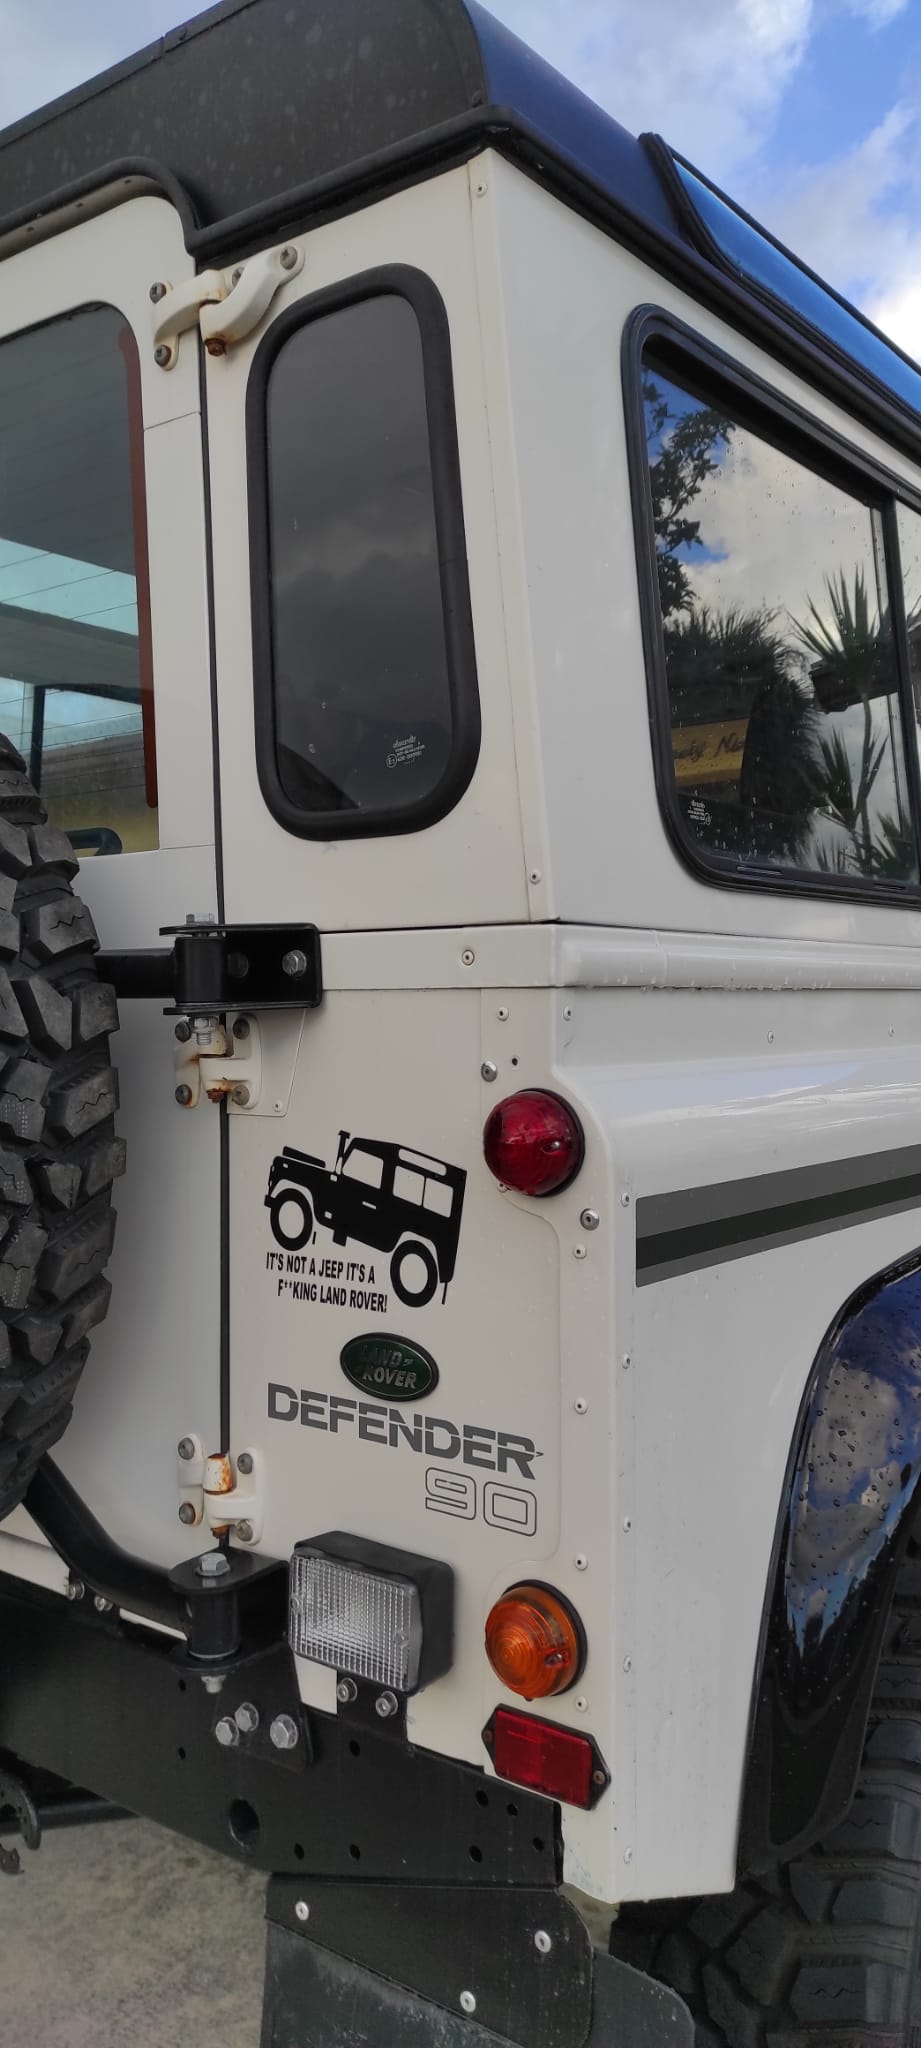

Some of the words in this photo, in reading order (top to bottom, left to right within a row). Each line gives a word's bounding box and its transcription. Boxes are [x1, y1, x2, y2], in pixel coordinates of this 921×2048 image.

[266, 1252, 284, 1271] IT'S
[286, 1255, 307, 1274] NOT
[309, 1258, 316, 1276] A
[318, 1259, 344, 1279] JEEP
[346, 1262, 366, 1282] IT'S
[368, 1265, 375, 1284] A
[320, 1285, 347, 1306] LAND
[349, 1289, 388, 1313] ROVER!
[362, 1364, 417, 1389] ROVER
[267, 1382, 537, 1480] DEFENDER
[425, 1467, 537, 1536] 90
